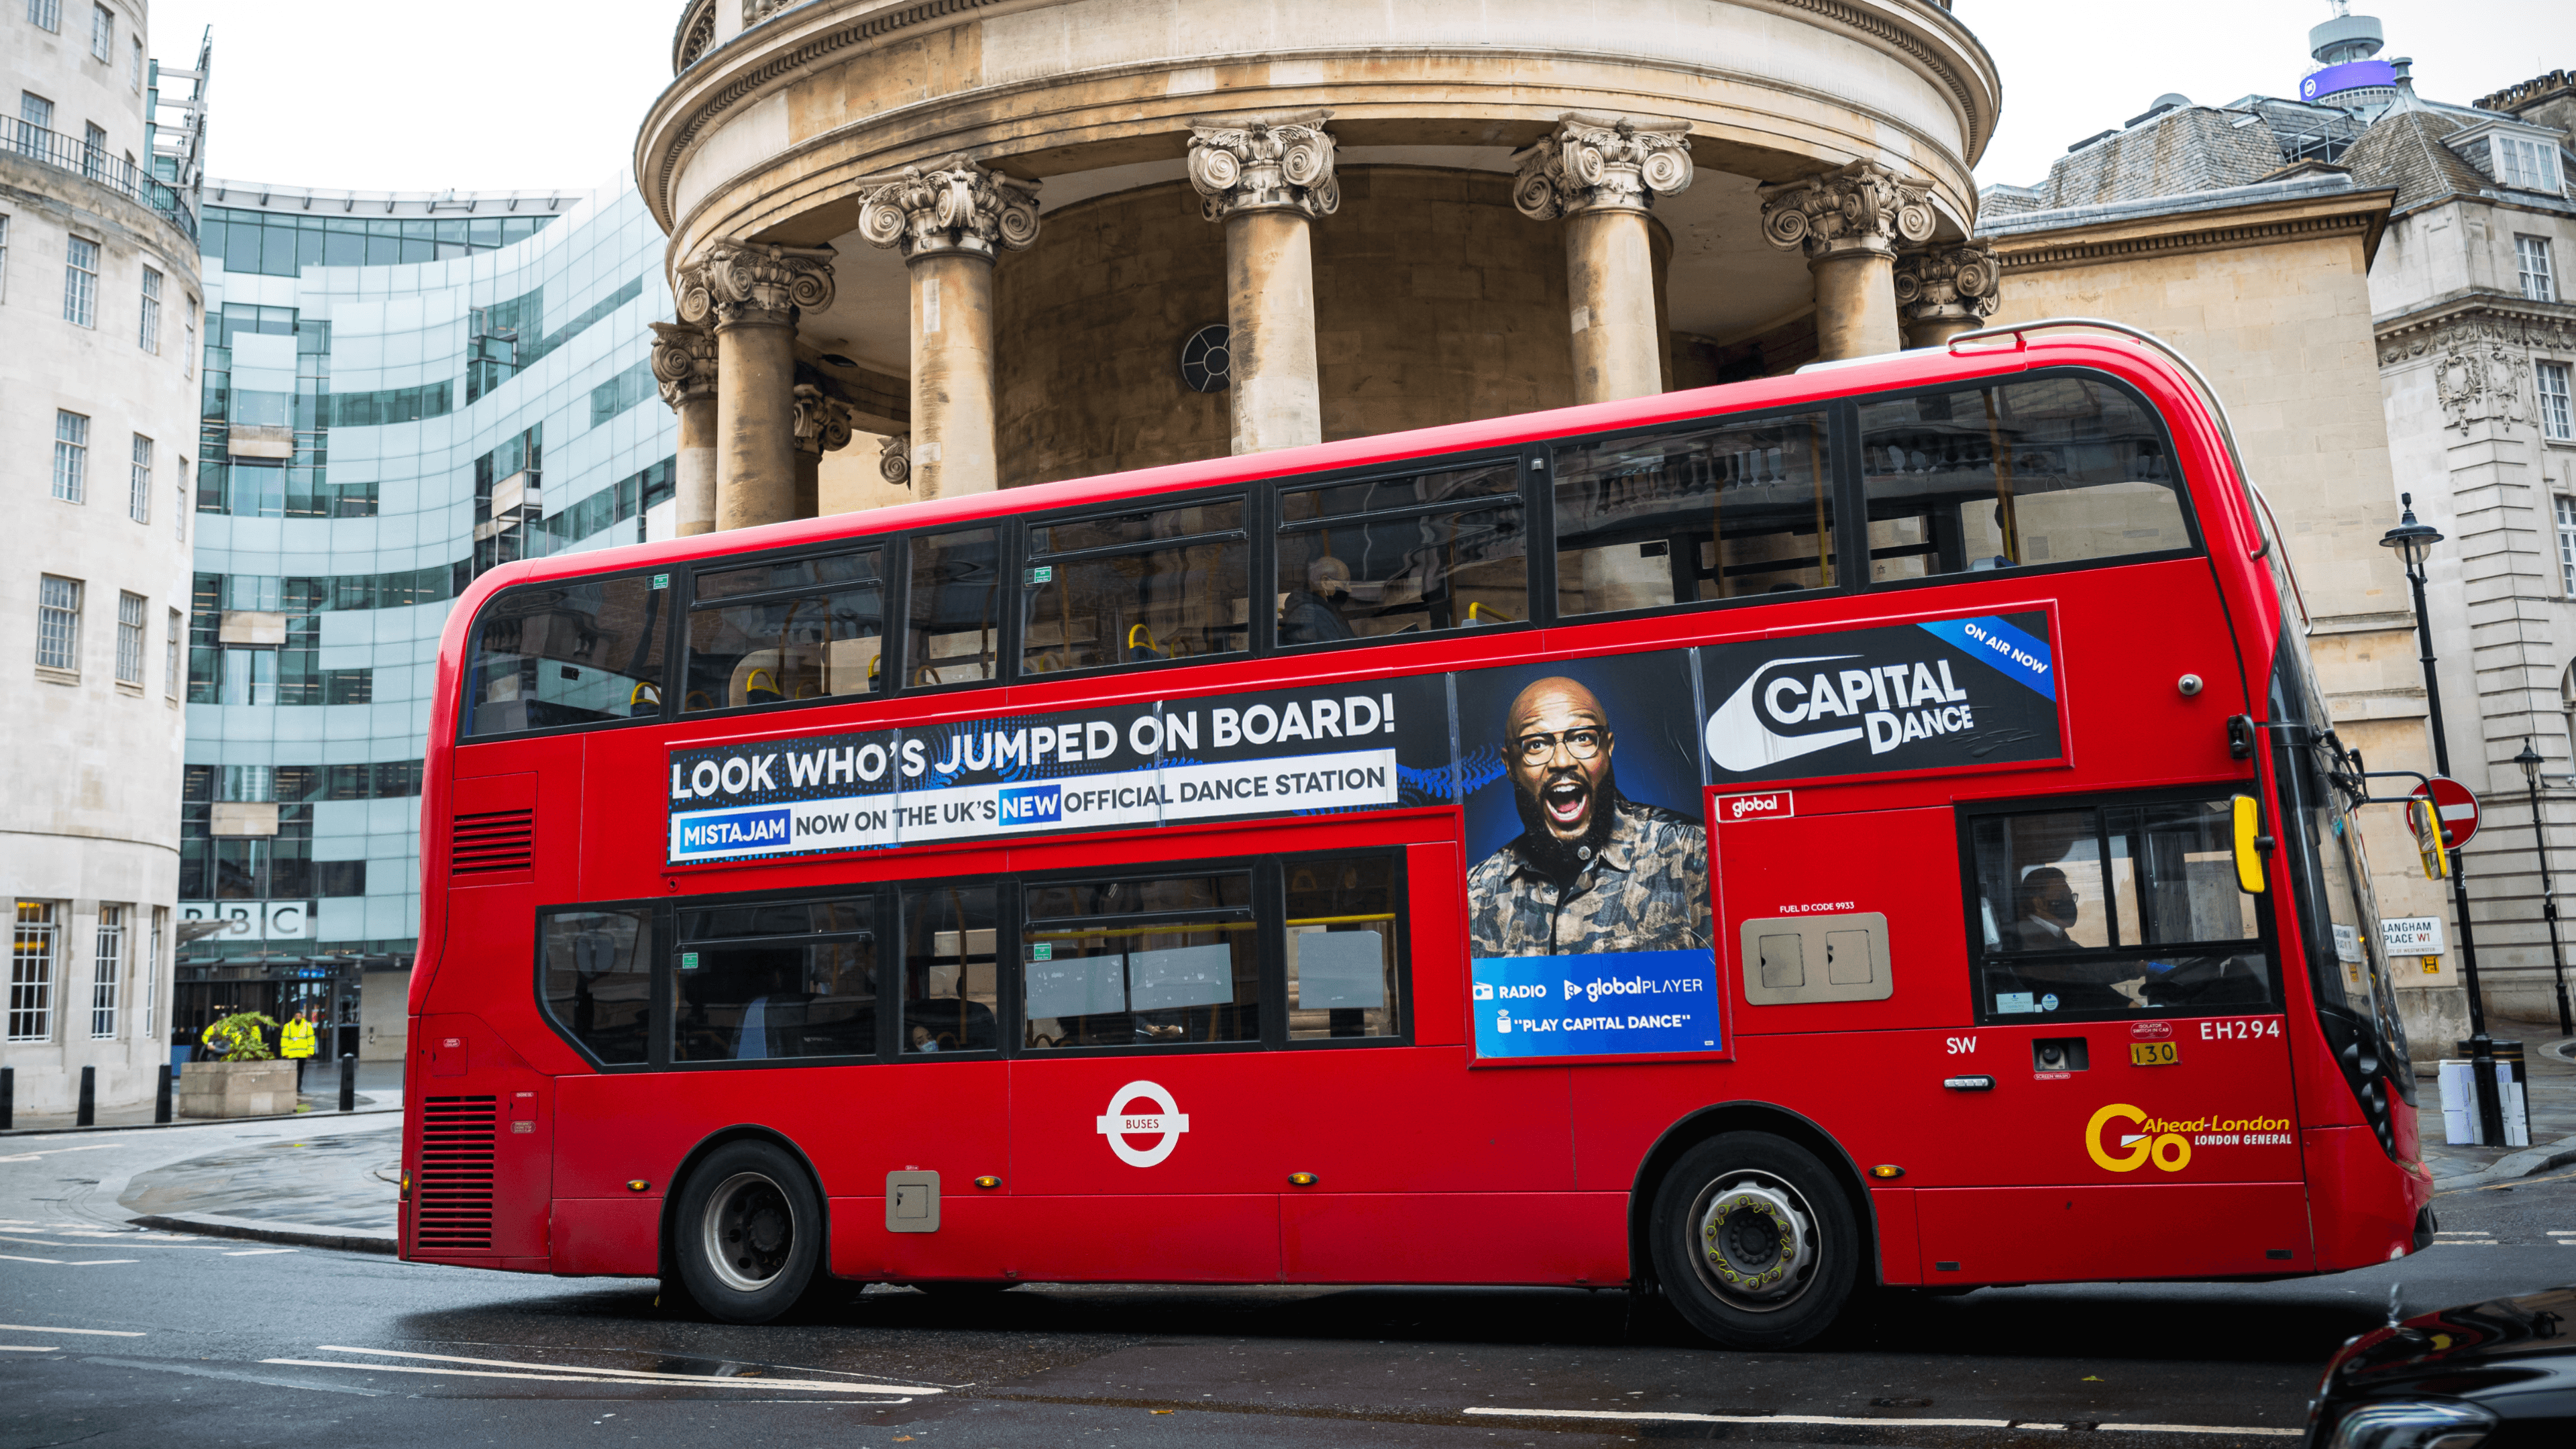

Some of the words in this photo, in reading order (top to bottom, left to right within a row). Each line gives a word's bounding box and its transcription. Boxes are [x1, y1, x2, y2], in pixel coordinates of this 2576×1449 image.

[1964, 623, 1987, 642] ON
[1986, 635, 2011, 655] AIR
[2011, 648, 2048, 674] NOW
[1764, 659, 1966, 724] CAPITAL
[672, 753, 777, 799] LOOK
[786, 739, 925, 788] WHO'S
[934, 721, 1118, 774] JUMPED
[1129, 711, 1198, 755] ON
[1213, 694, 1395, 748] BOARD!
[684, 818, 785, 847] MISTAJAM
[796, 813, 849, 836] NOW
[855, 810, 887, 831] ON
[892, 805, 937, 827] THE
[943, 800, 996, 823] UK'S
[1002, 793, 1059, 818] NEW
[1064, 784, 1173, 813] OFFICIAL
[1180, 776, 1268, 803] DANCE
[1275, 767, 1385, 796] STATION
[1732, 795, 1778, 818] global
[1780, 905, 1800, 913] FUEL
[1811, 903, 1834, 911] CODE
[1835, 902, 1854, 910] 9933
[2382, 922, 2431, 932] LANGHAM
[2384, 934, 2414, 944] PLACE
[2417, 933, 2430, 942] W1
[1499, 985, 1546, 998] RADIO
[1514, 1019, 1558, 1032] "PLAY
[1562, 1017, 1625, 1031] CAPITAL
[1628, 1014, 1691, 1029] DANCE"
[2200, 1020, 2279, 1040] EH294
[1947, 1036, 1976, 1055] SW
[2136, 1044, 2174, 1063] 130
[1126, 1118, 1159, 1129] BUSES
[2086, 1104, 2191, 1172] Go
[2142, 1115, 2290, 1132] Ahead-London
[2195, 1134, 2239, 1145] LONDON
[2243, 1134, 2292, 1144] GENERAL
